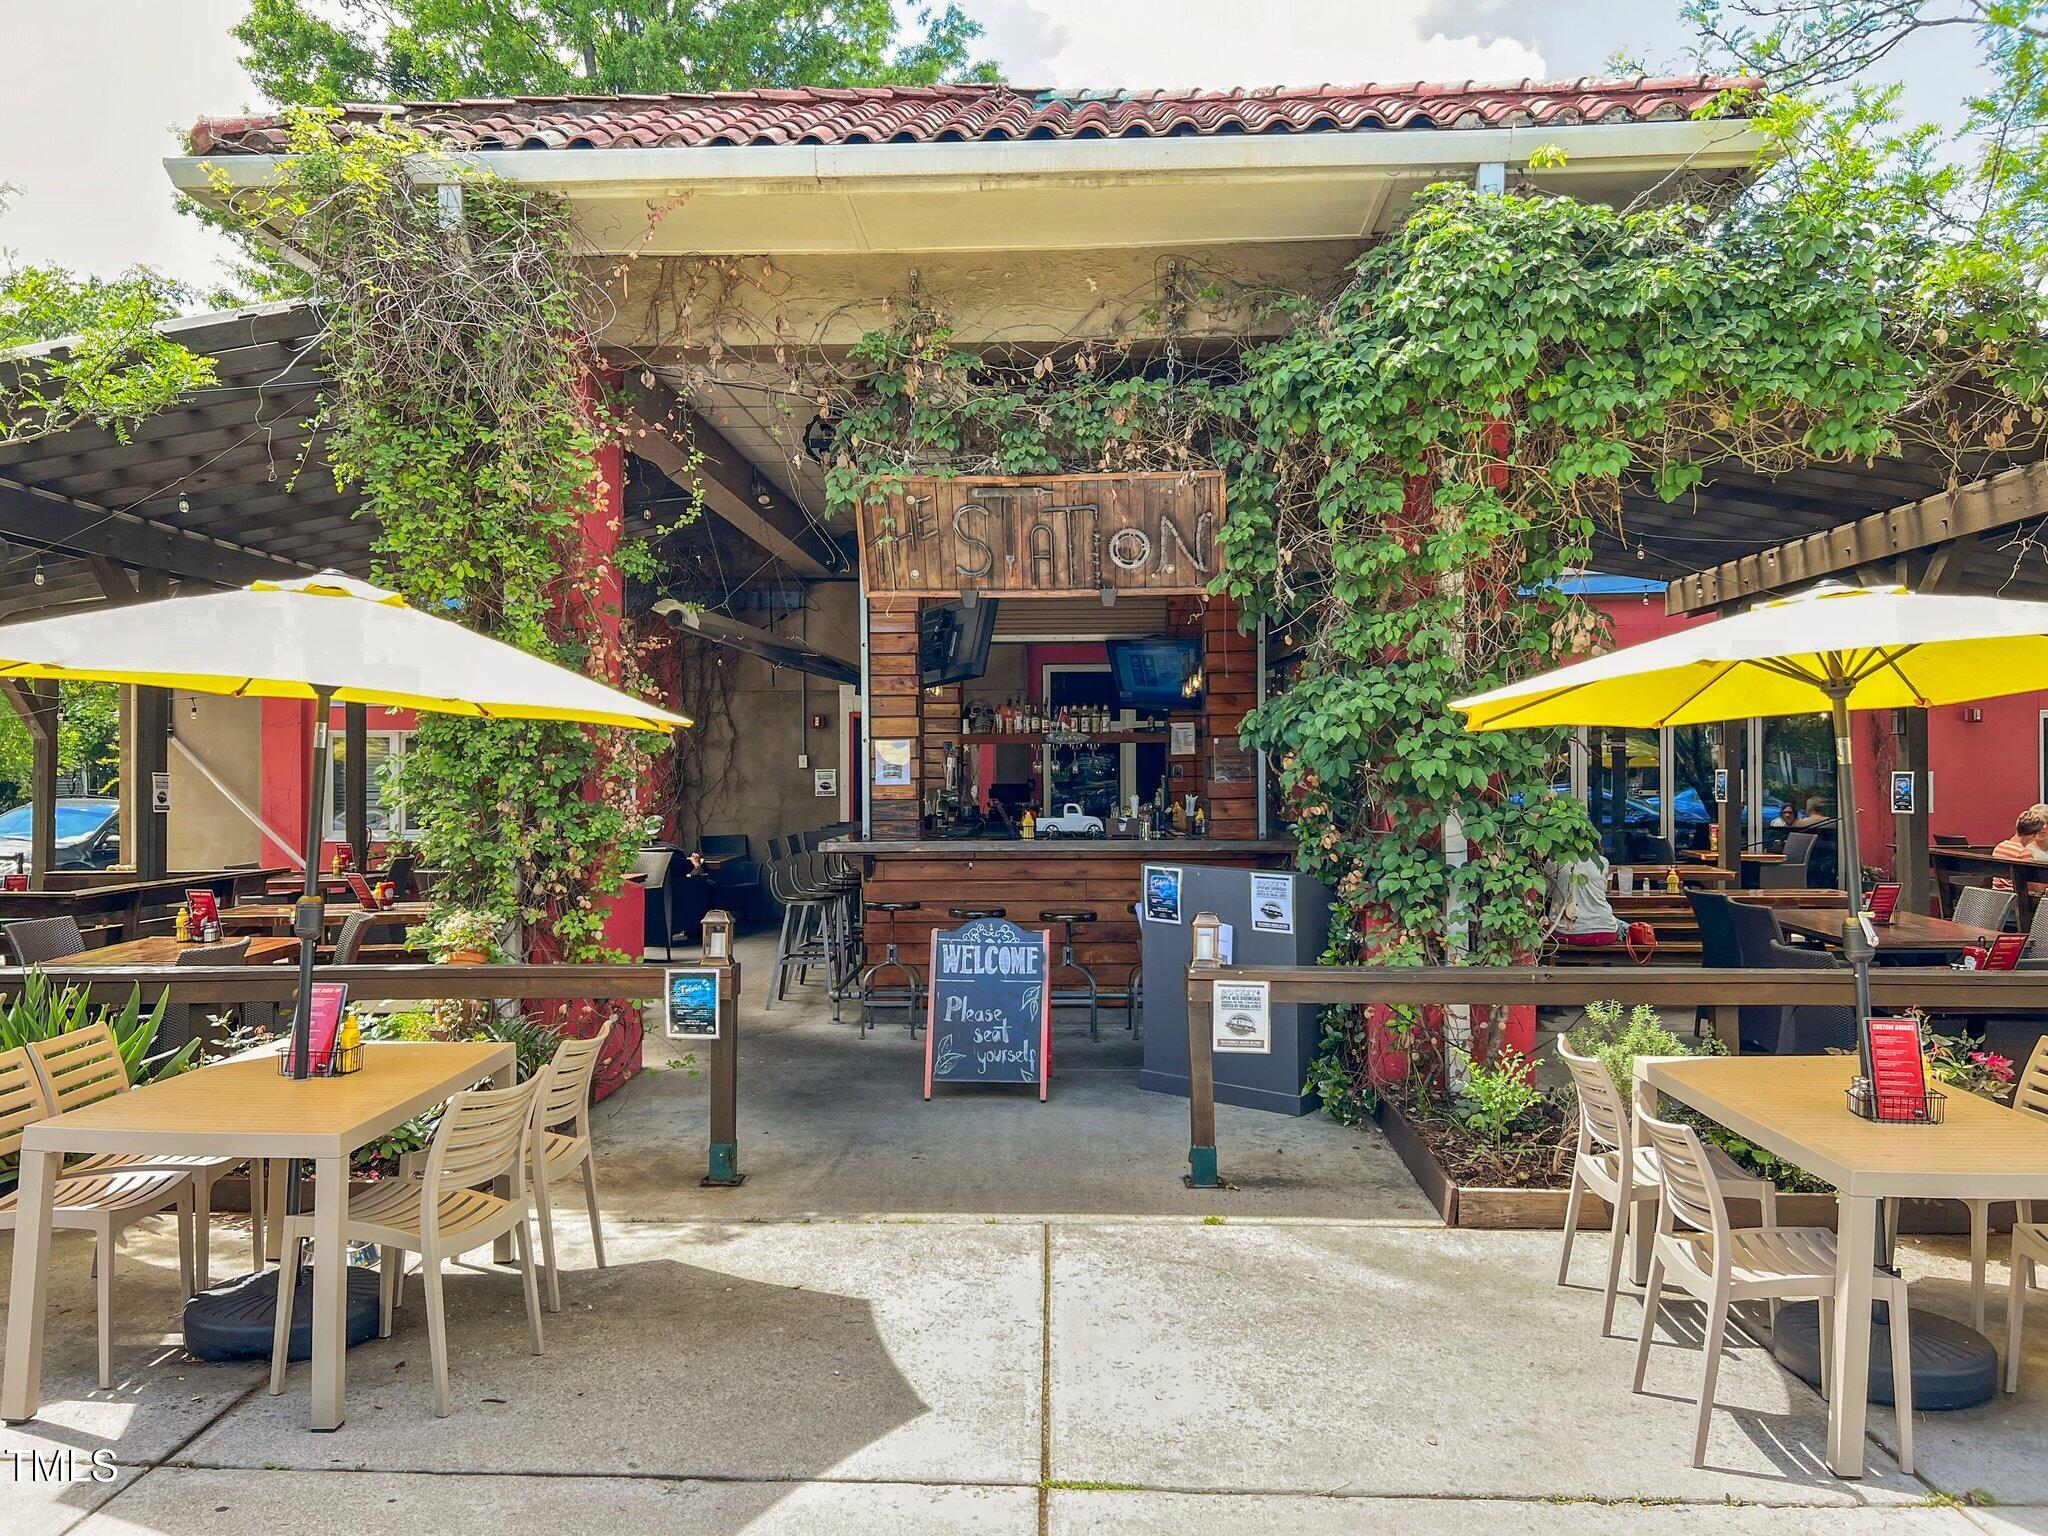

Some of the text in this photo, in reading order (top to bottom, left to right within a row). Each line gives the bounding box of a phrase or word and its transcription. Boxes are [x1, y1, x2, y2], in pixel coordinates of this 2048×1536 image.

[952, 486, 1213, 589] STATION
[942, 944, 1038, 975] WELCOME
[943, 995, 1003, 1022] Please
[973, 1018, 1011, 1044] seat
[977, 1039, 1036, 1074] yourself
